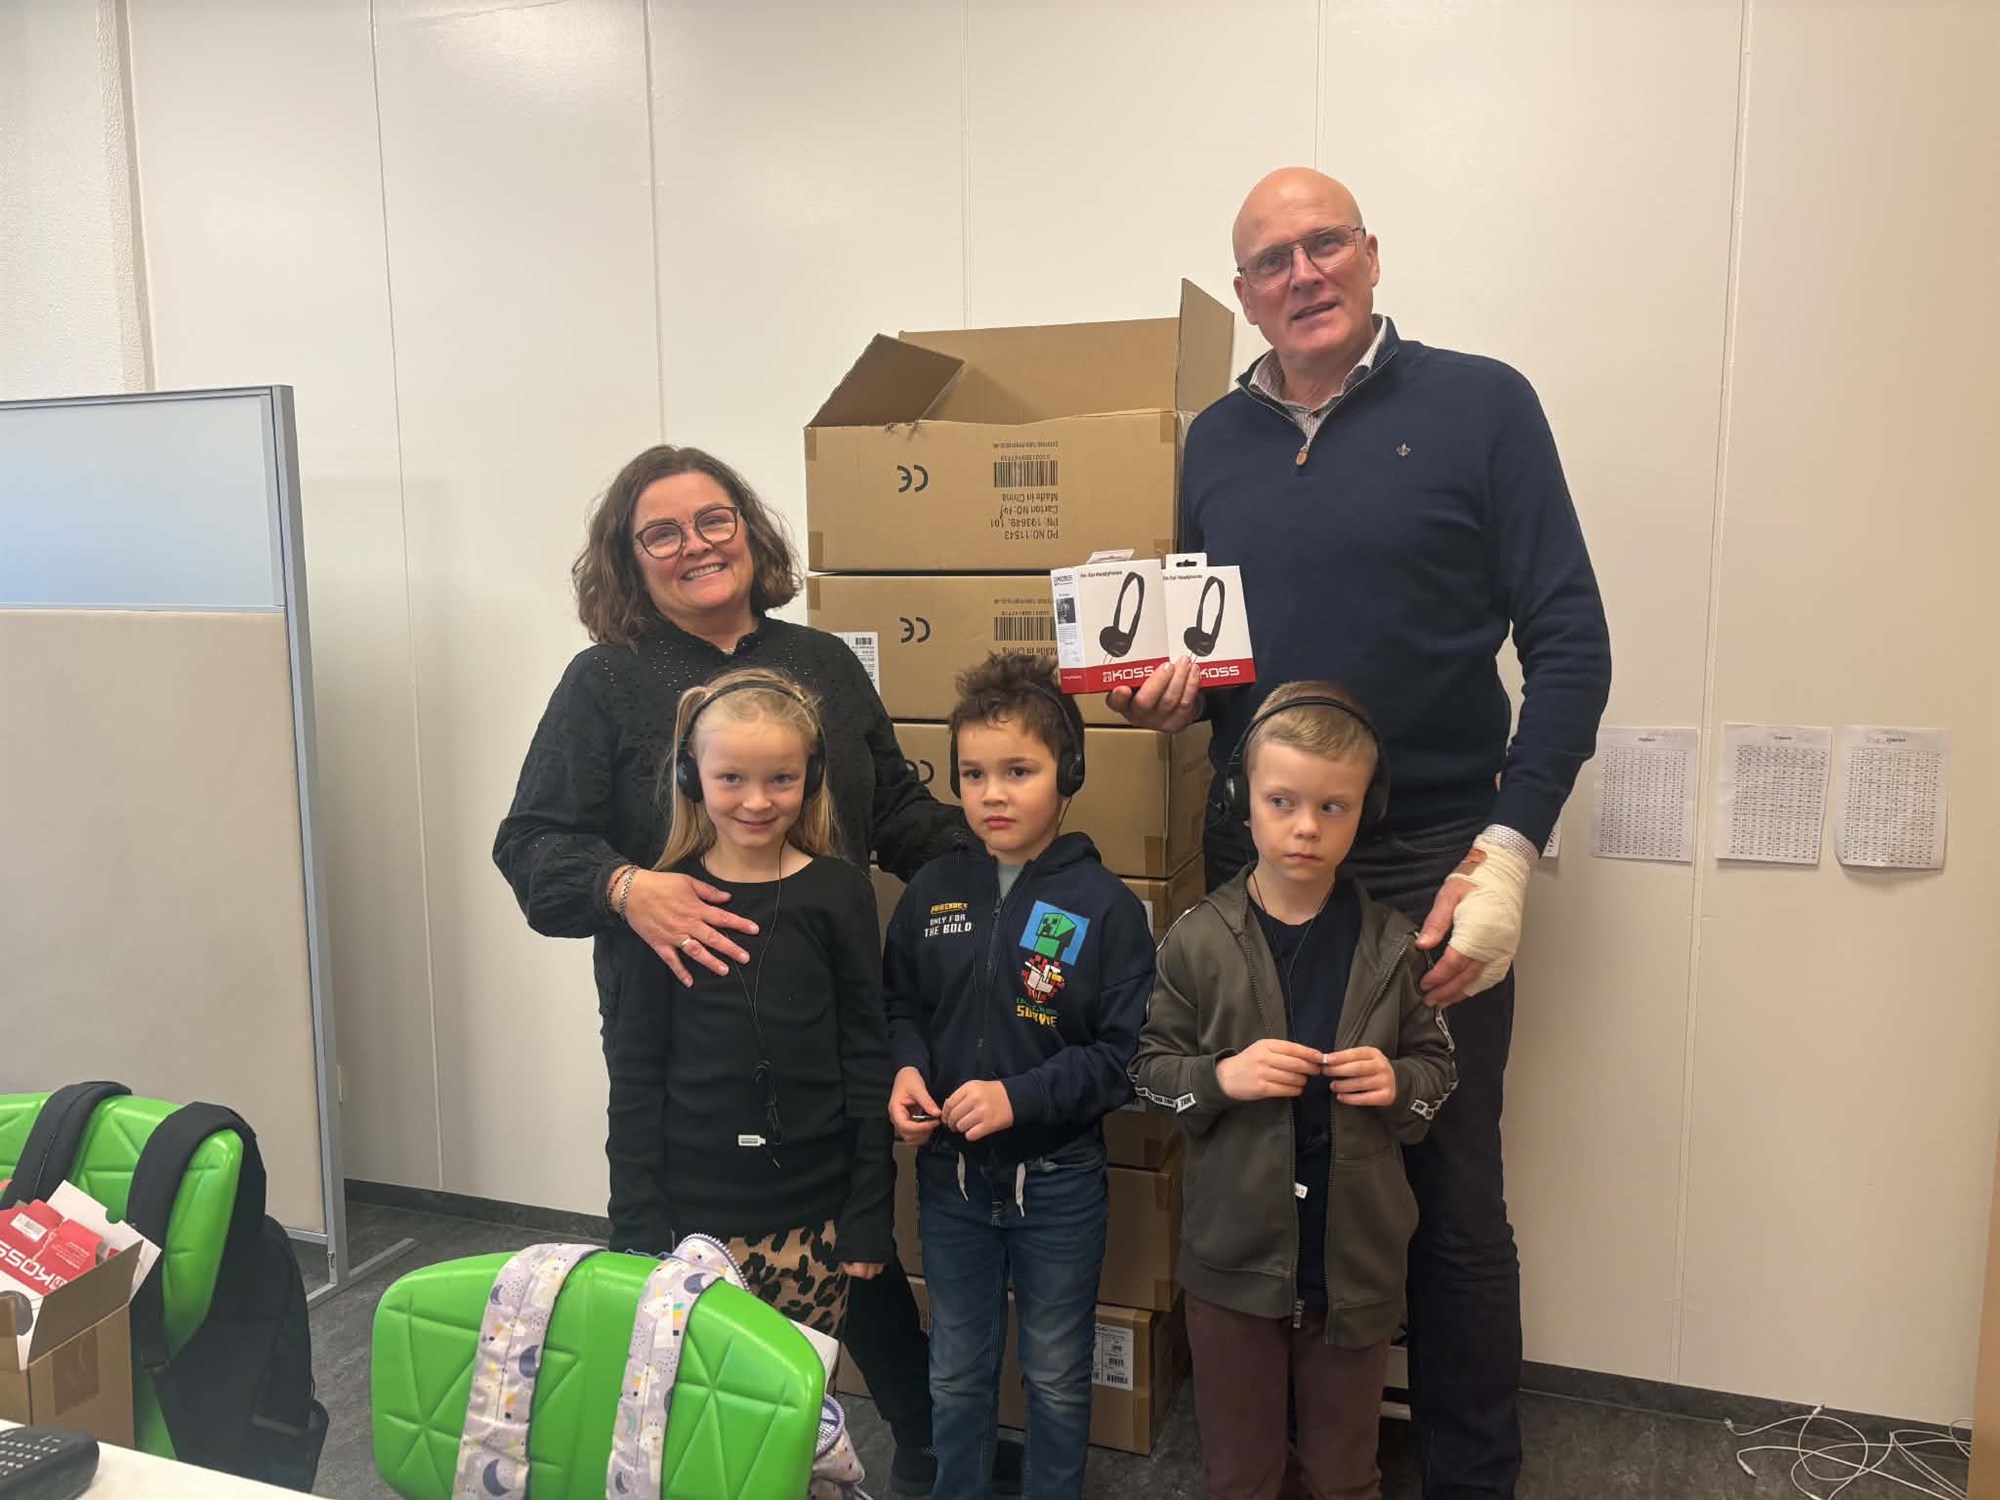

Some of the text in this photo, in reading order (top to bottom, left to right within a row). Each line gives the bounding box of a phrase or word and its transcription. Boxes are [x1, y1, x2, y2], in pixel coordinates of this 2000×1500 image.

[1002, 493, 1058, 502] Made in China
[1031, 505, 1058, 514] Carton
[1047, 530, 1058, 539] PO
[1112, 665, 1154, 681] KOSS
[1199, 665, 1240, 679] KOSS
[930, 913, 966, 926] ONLY FOR
[924, 921, 972, 938] THE BOLD
